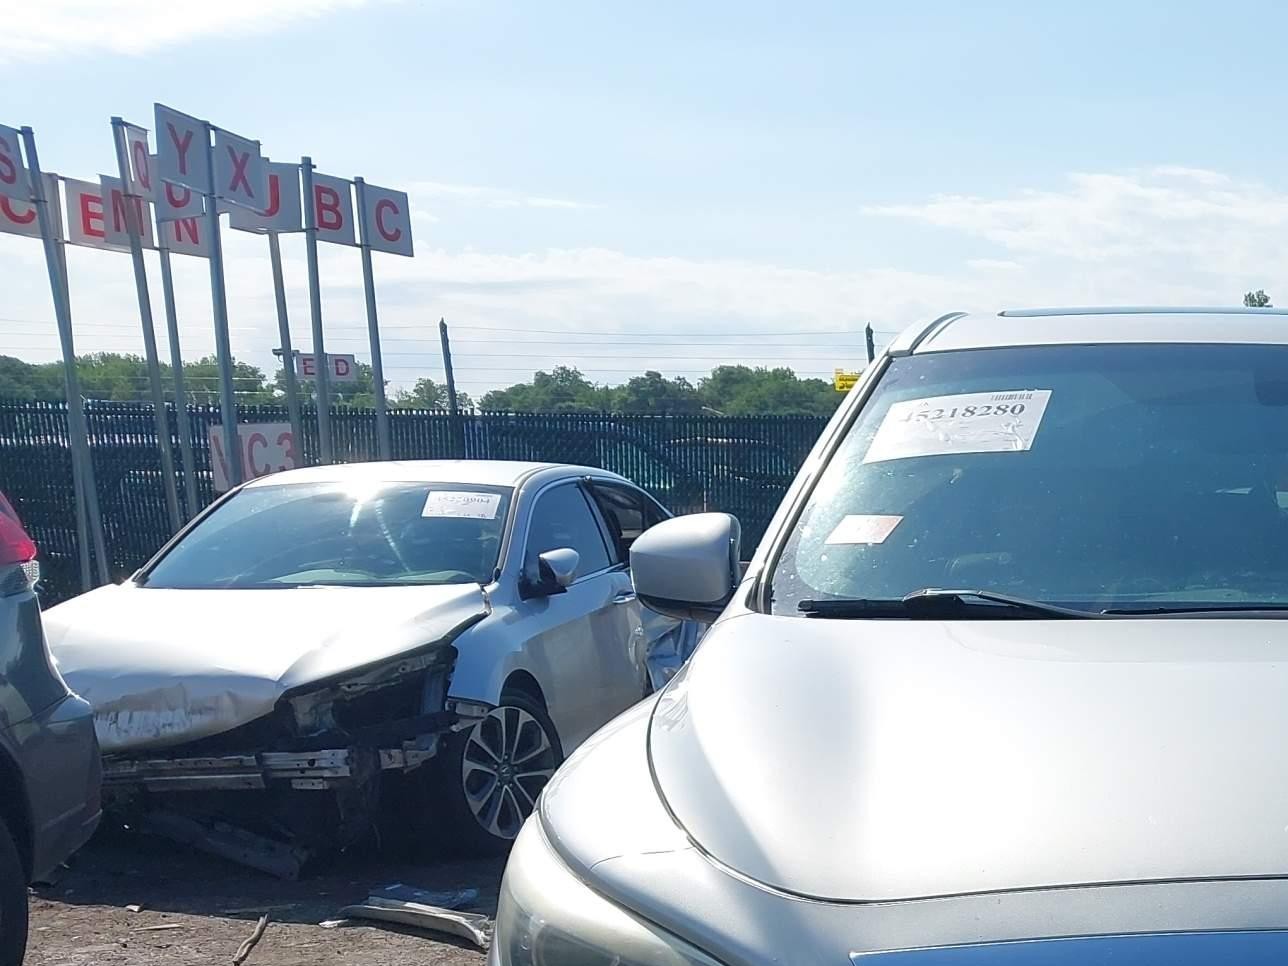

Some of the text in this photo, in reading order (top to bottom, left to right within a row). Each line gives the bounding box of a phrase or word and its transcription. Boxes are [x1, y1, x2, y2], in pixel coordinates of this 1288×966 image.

[167, 121, 194, 176] Y
[227, 145, 255, 199] X
[80, 193, 105, 238] E
[314, 184, 343, 230] B
[375, 198, 401, 242] C
[302, 357, 350, 377] E D
